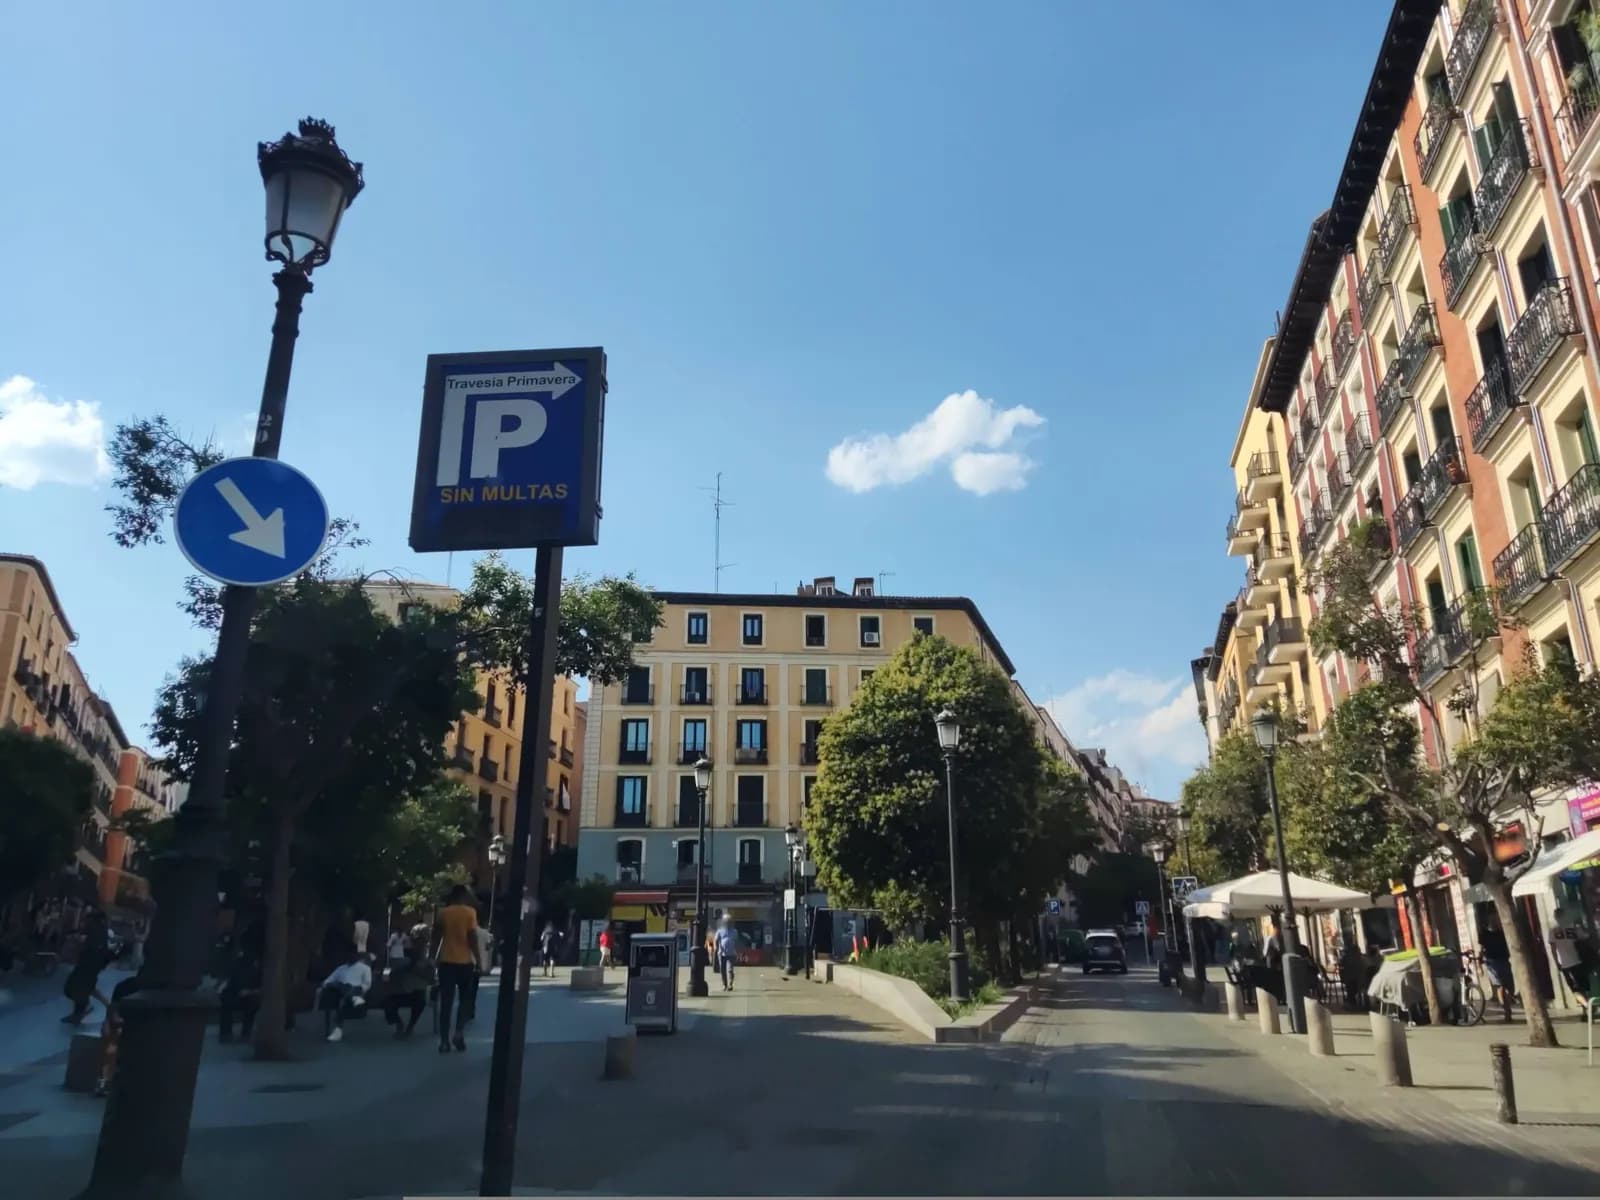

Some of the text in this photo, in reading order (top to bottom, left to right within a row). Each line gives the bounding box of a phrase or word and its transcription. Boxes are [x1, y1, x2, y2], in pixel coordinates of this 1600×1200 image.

[507, 375, 576, 387] Primavera
[470, 399, 547, 479] P
[440, 484, 568, 503] SIN MULTAS
